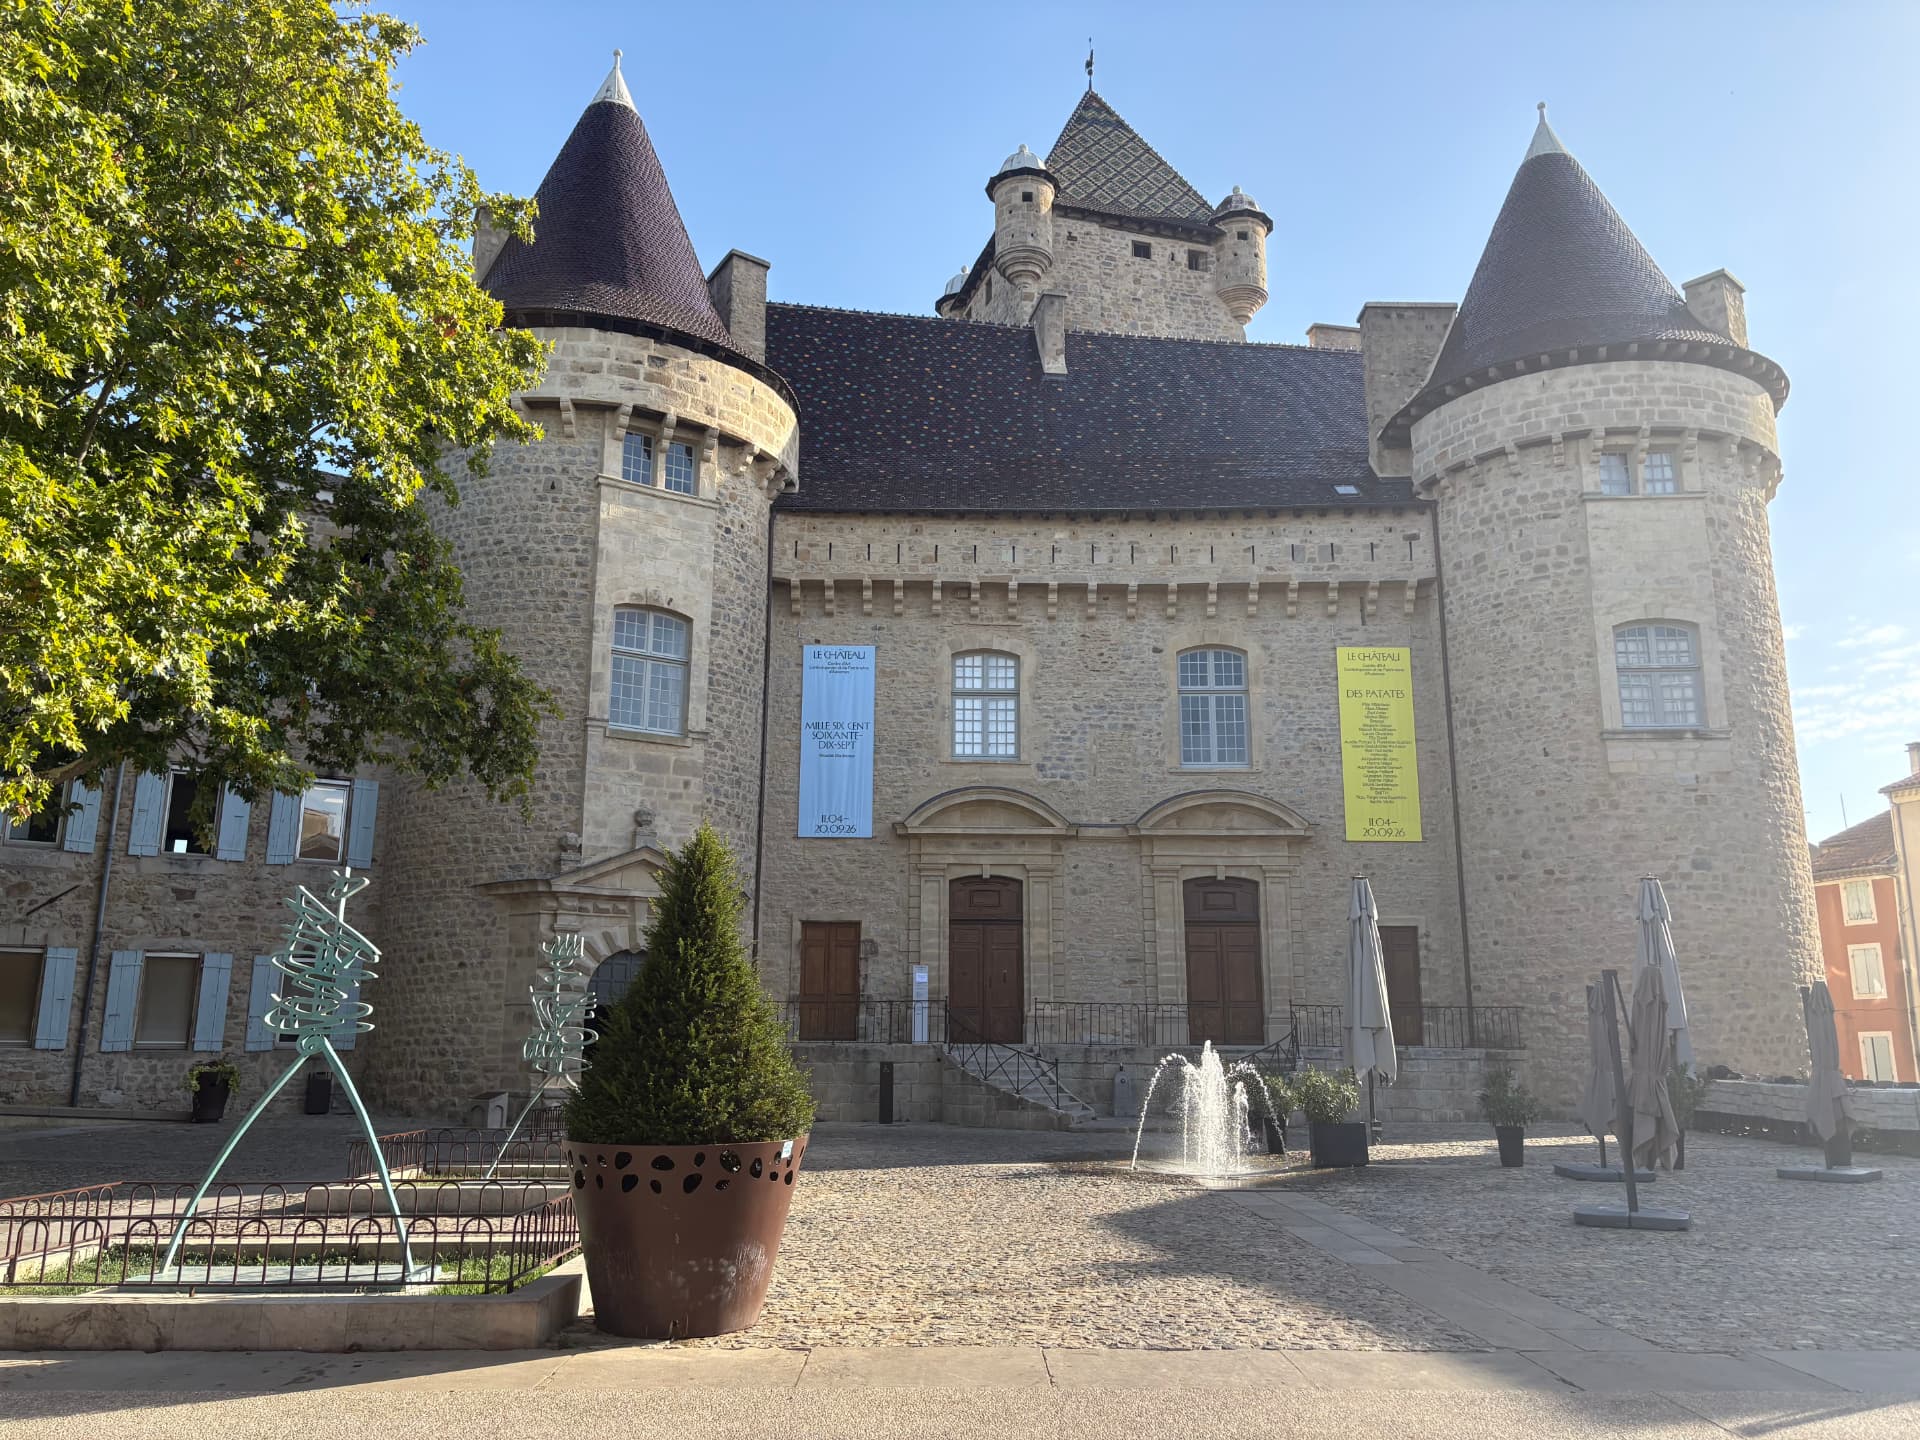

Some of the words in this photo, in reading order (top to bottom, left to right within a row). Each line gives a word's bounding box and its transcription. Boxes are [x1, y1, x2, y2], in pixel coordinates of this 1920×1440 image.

[813, 650, 822, 659] LE
[824, 648, 866, 660] CHÂTEAU
[1347, 652, 1356, 661] LE
[1357, 650, 1400, 661] CHÂTEAU
[1346, 689, 1362, 698] DES
[1365, 689, 1405, 698] PATATES
[805, 721, 830, 730] MILLE
[832, 721, 844, 730] SIX
[847, 721, 871, 730] CENT
[811, 731, 863, 740] SOIXANTE-
[818, 740, 856, 749] DIX-SEPT
[815, 824, 857, 833] 20.09.26
[1363, 827, 1406, 837] 20.09.26
